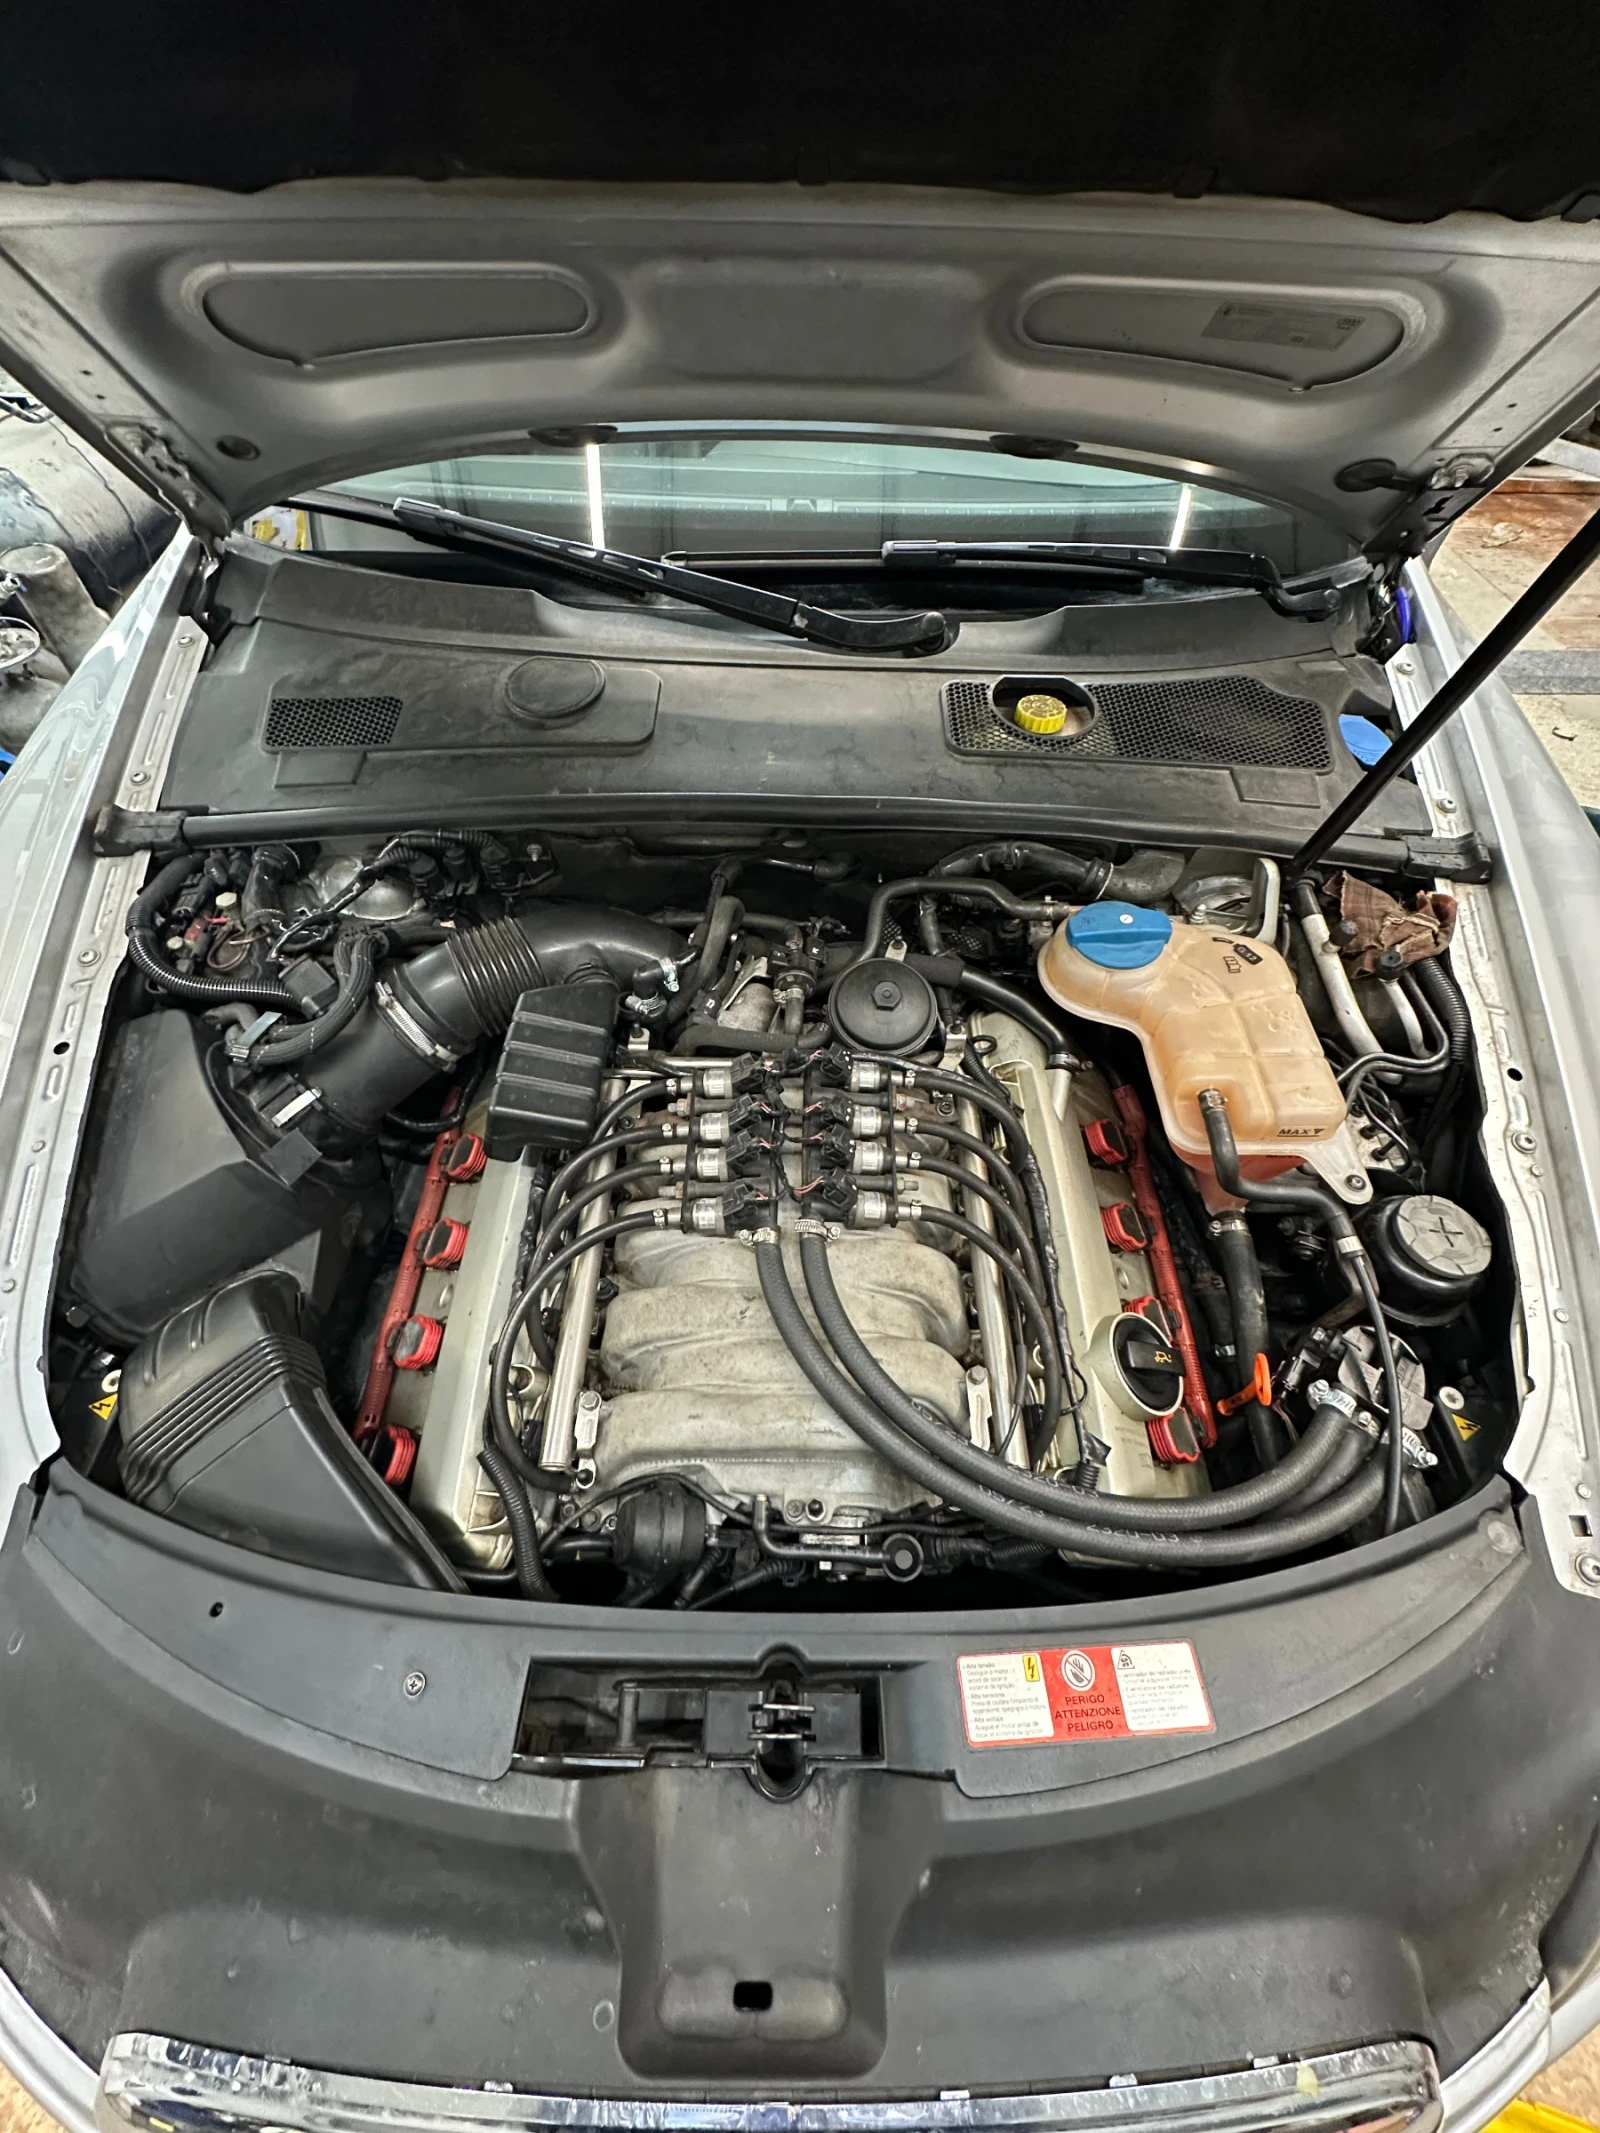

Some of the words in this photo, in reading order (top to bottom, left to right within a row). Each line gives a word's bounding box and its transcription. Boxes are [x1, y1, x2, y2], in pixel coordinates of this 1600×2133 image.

[1065, 1694, 1105, 1706] PERIGO
[1055, 1706, 1121, 1720] ATTENZIONE
[1067, 1720, 1113, 1732] PELIGRO
